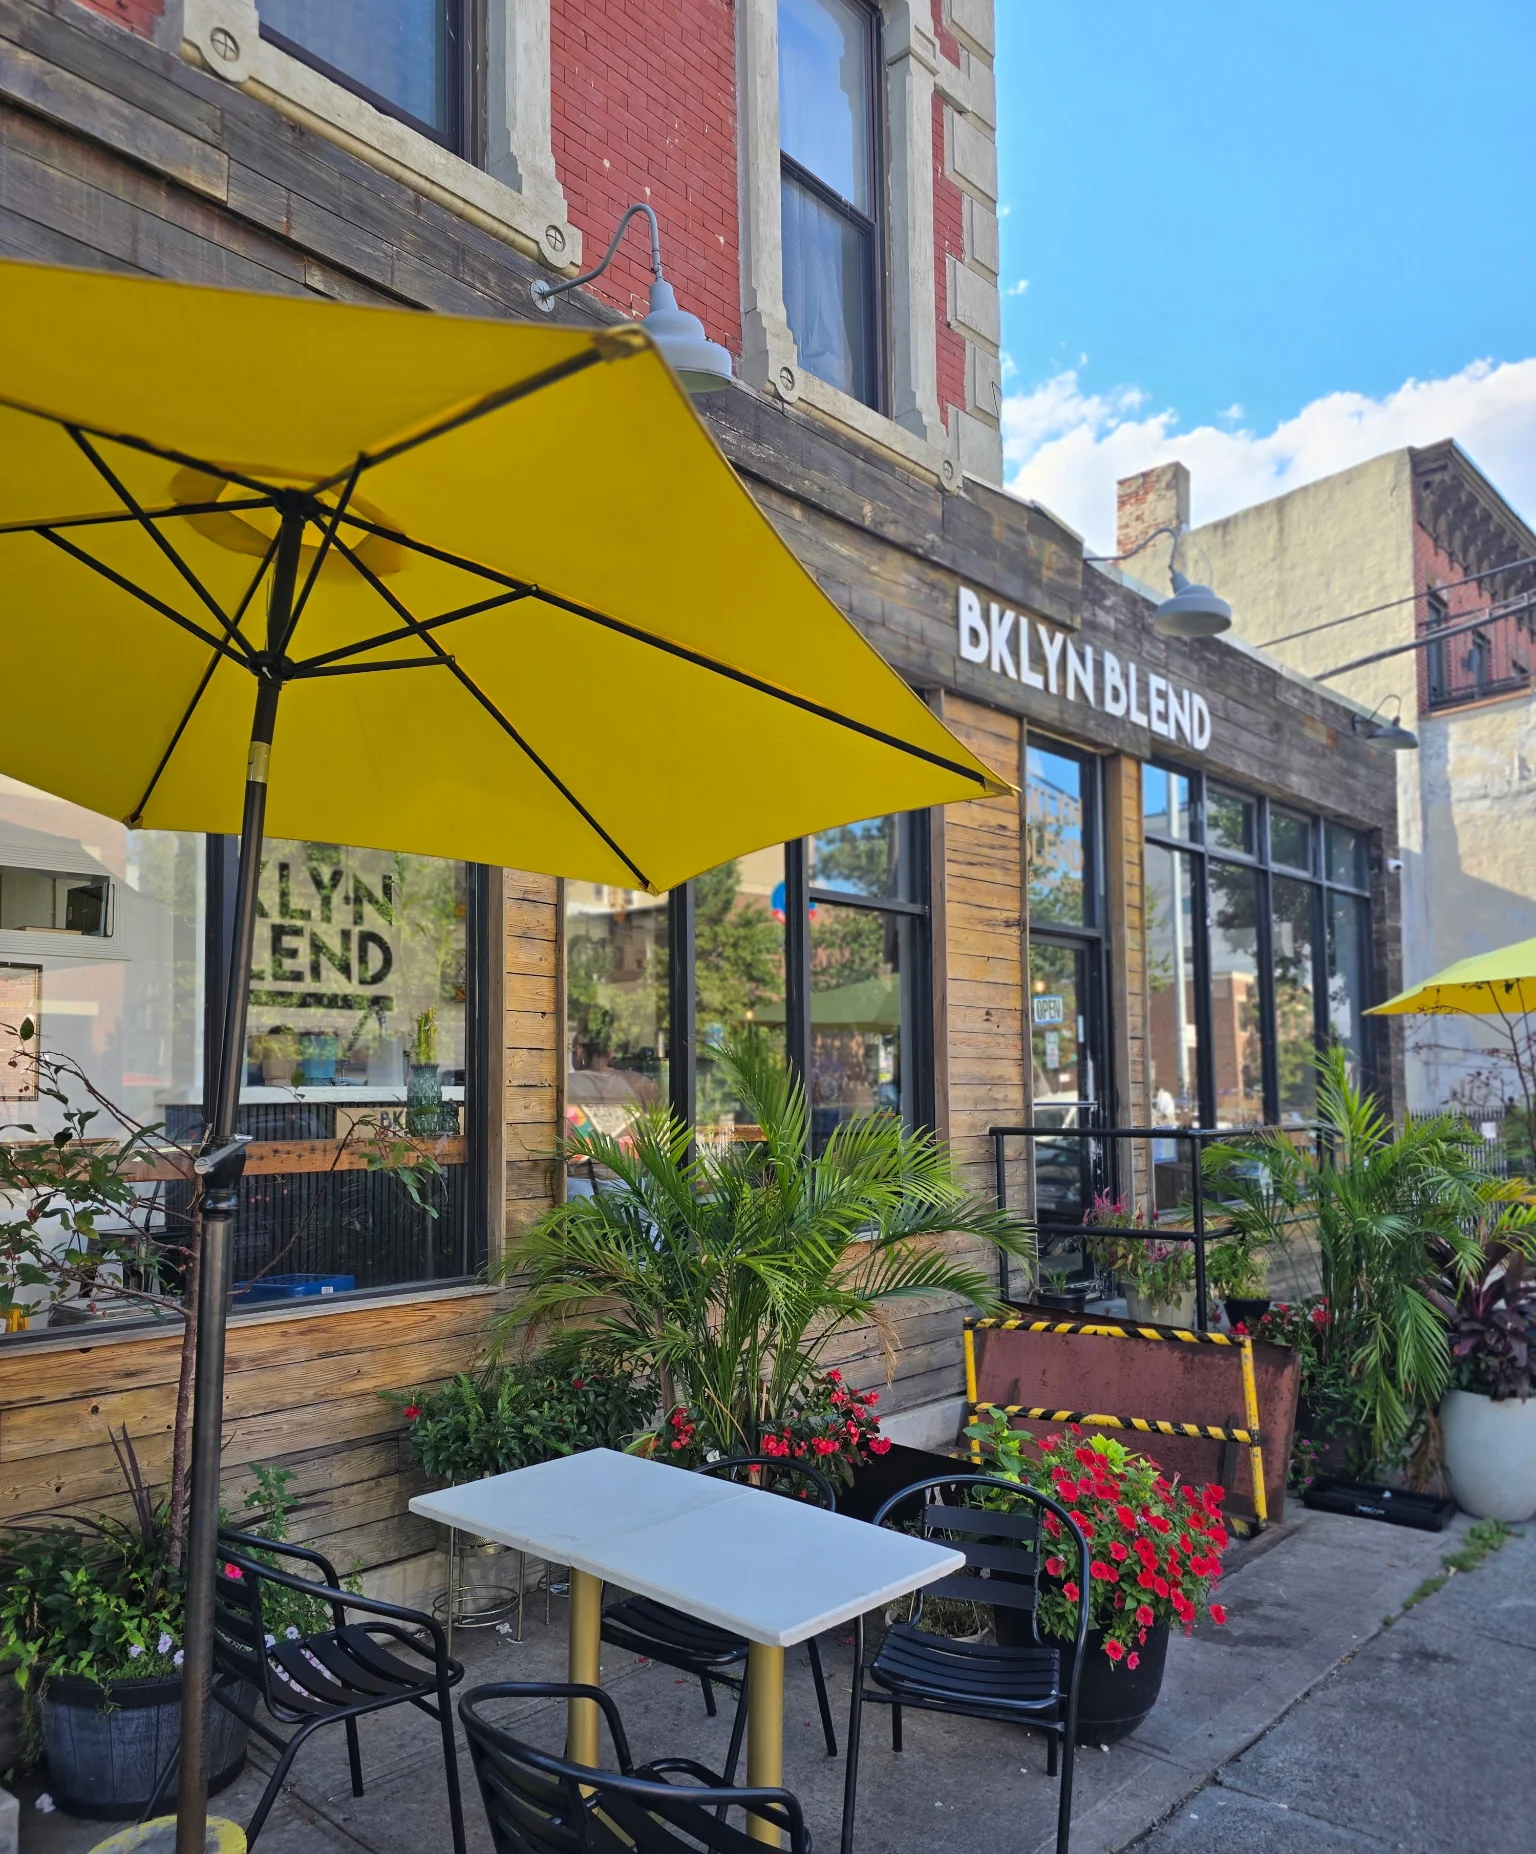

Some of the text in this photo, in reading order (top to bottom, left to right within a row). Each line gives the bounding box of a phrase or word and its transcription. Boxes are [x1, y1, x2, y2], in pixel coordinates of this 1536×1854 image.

[958, 586, 1212, 750] BKLYN BLEND
[1036, 999, 1061, 1020] OPEN
